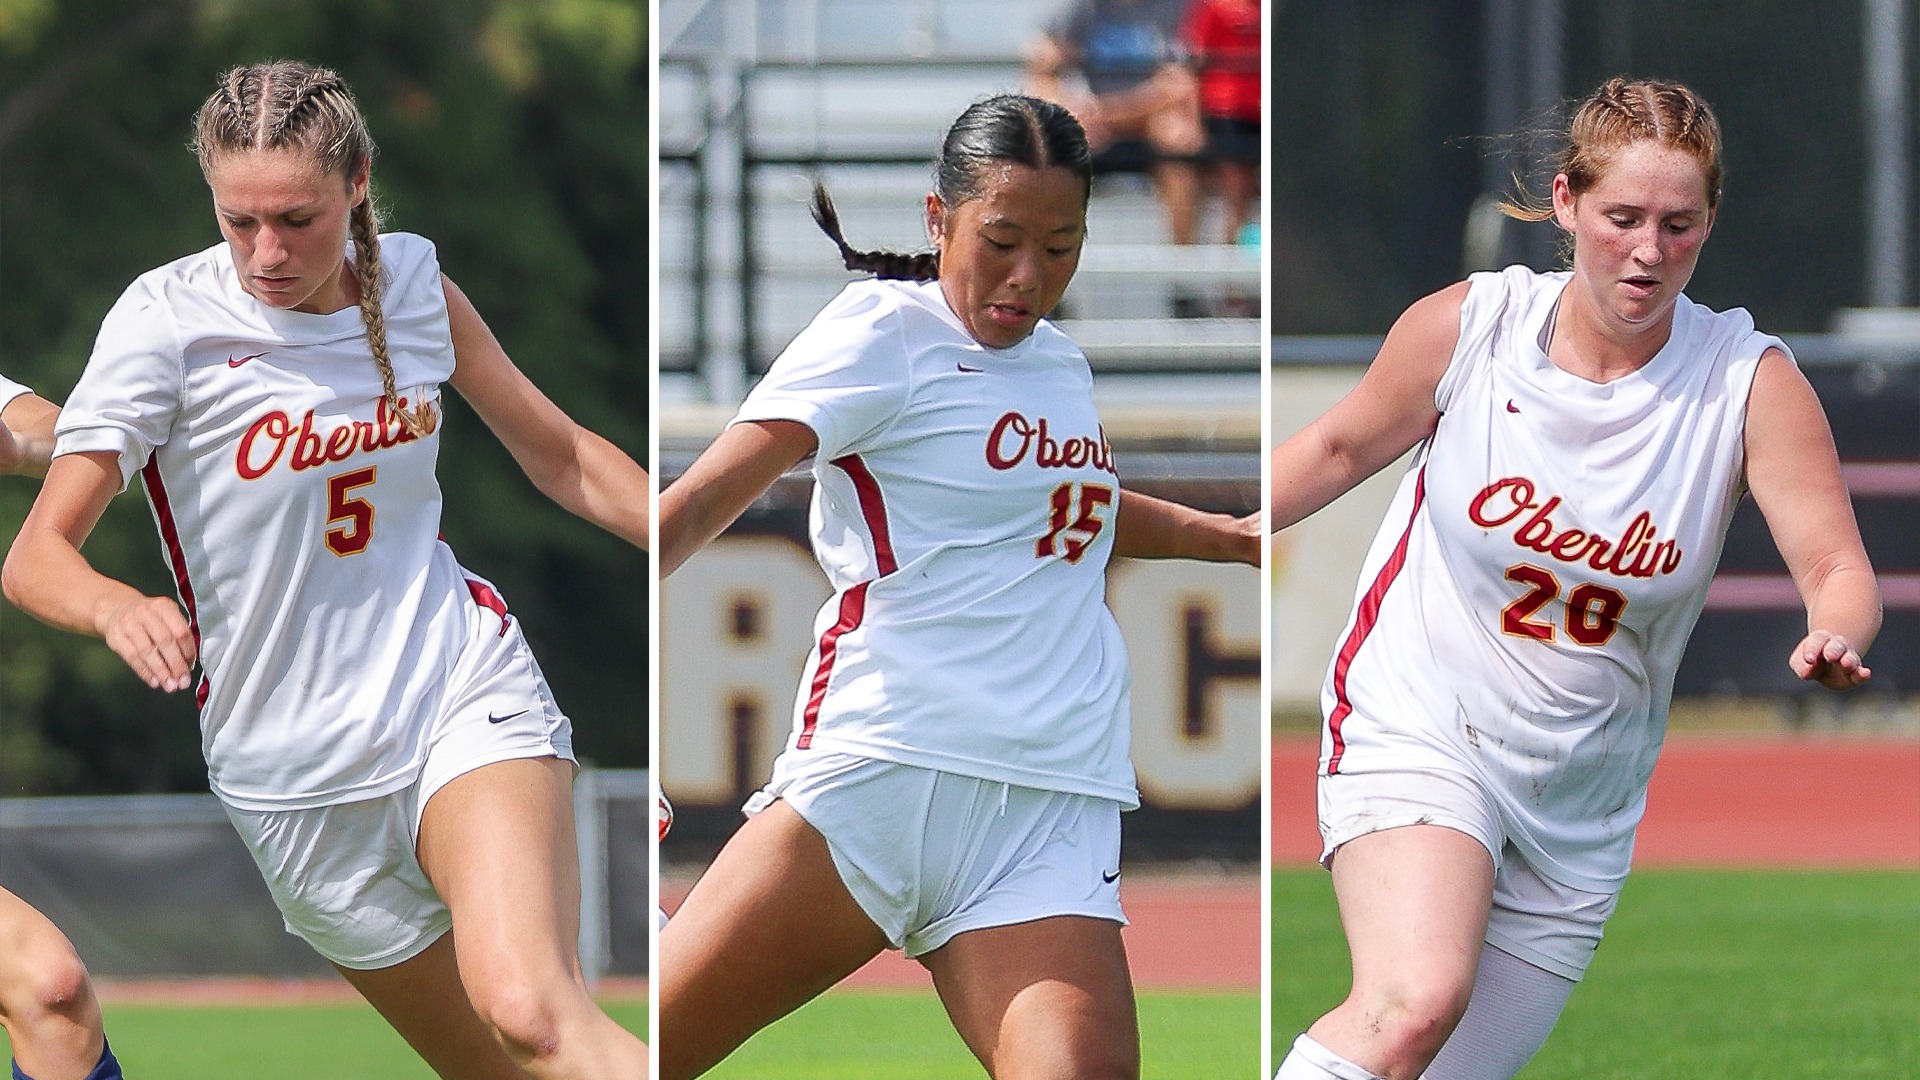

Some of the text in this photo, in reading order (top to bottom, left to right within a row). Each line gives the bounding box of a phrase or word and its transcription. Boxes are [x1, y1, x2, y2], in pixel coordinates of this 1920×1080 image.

[324, 464, 377, 557] 5
[1034, 480, 1113, 565] 15
[1467, 475, 1683, 579] Oberlin
[1500, 561, 1629, 646] 20
